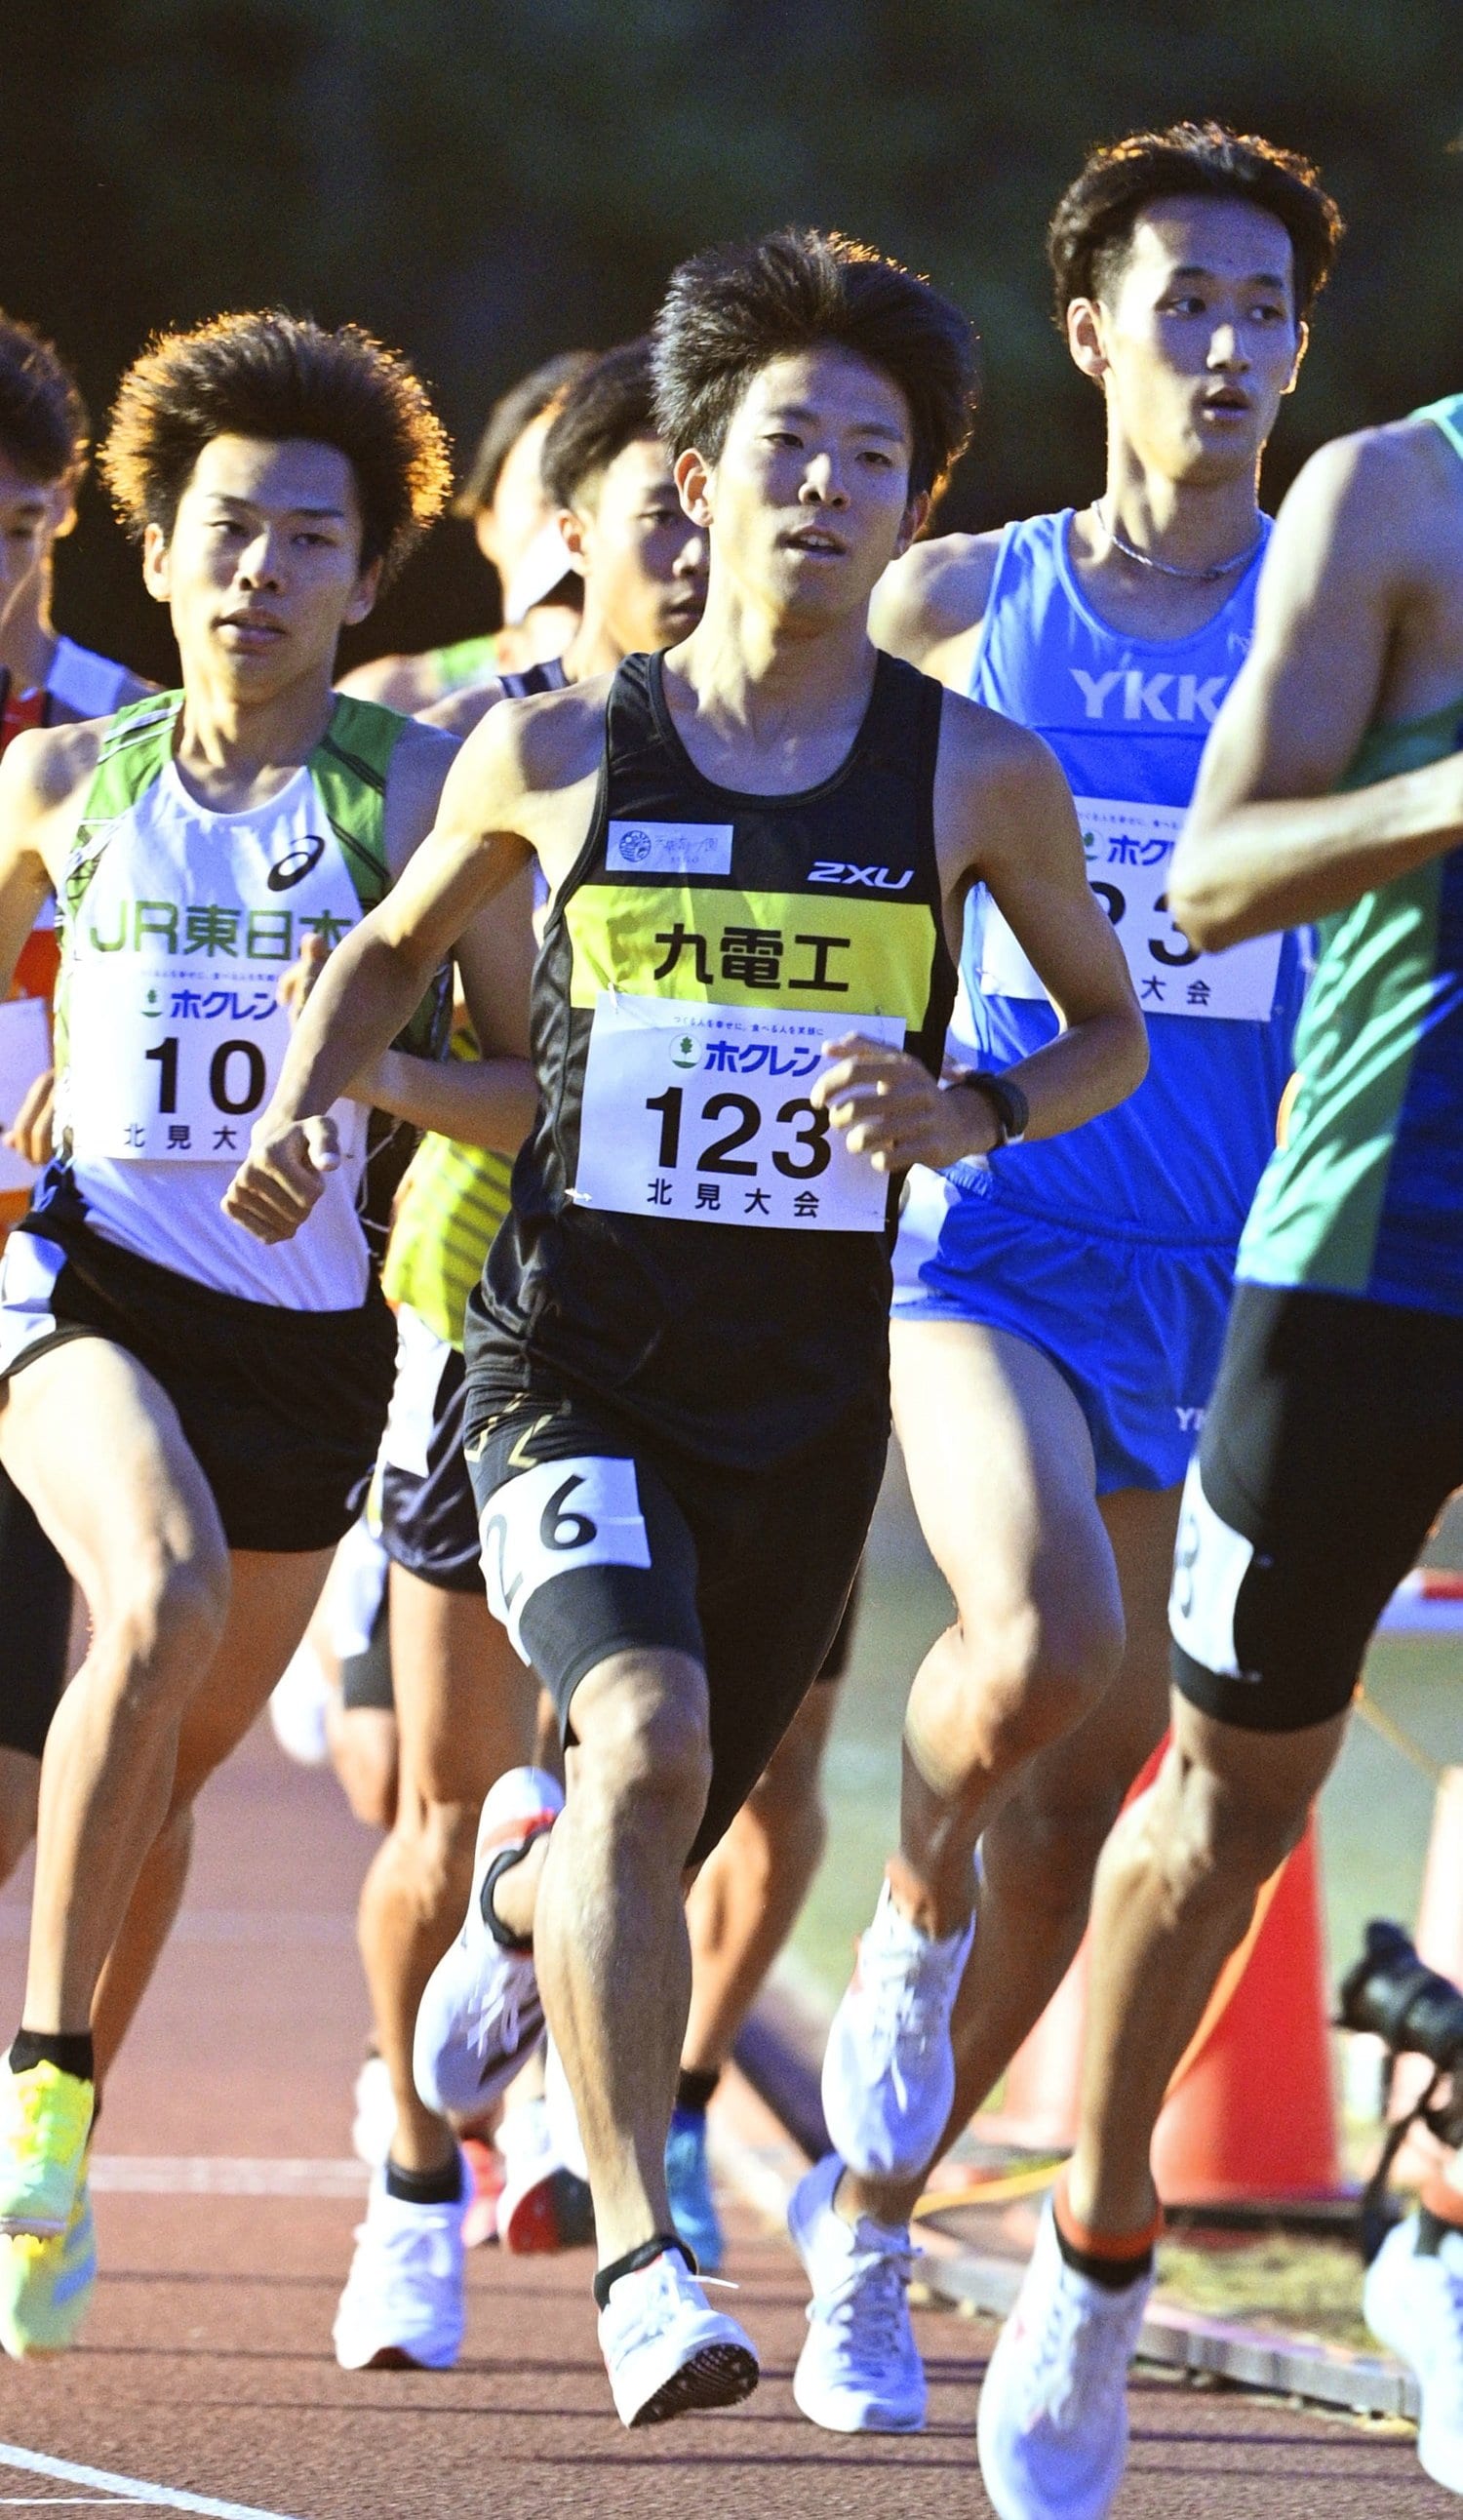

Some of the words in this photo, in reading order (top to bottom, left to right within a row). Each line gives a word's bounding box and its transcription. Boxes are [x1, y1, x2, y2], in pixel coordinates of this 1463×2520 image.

[1070, 667, 1228, 723] YKK
[1107, 834, 1176, 866] ホク
[807, 860, 914, 890] 2XU
[89, 900, 353, 962] JR東日本
[653, 922, 851, 992] 九電工
[170, 988, 279, 1020] ホクレン
[1140, 975, 1211, 1007] 大会
[144, 1036, 267, 1116] 10
[703, 1039, 822, 1077] ホクレン
[123, 1124, 238, 1150] 北見大
[646, 1086, 831, 1180] 123
[647, 1177, 820, 1219] 北見大会
